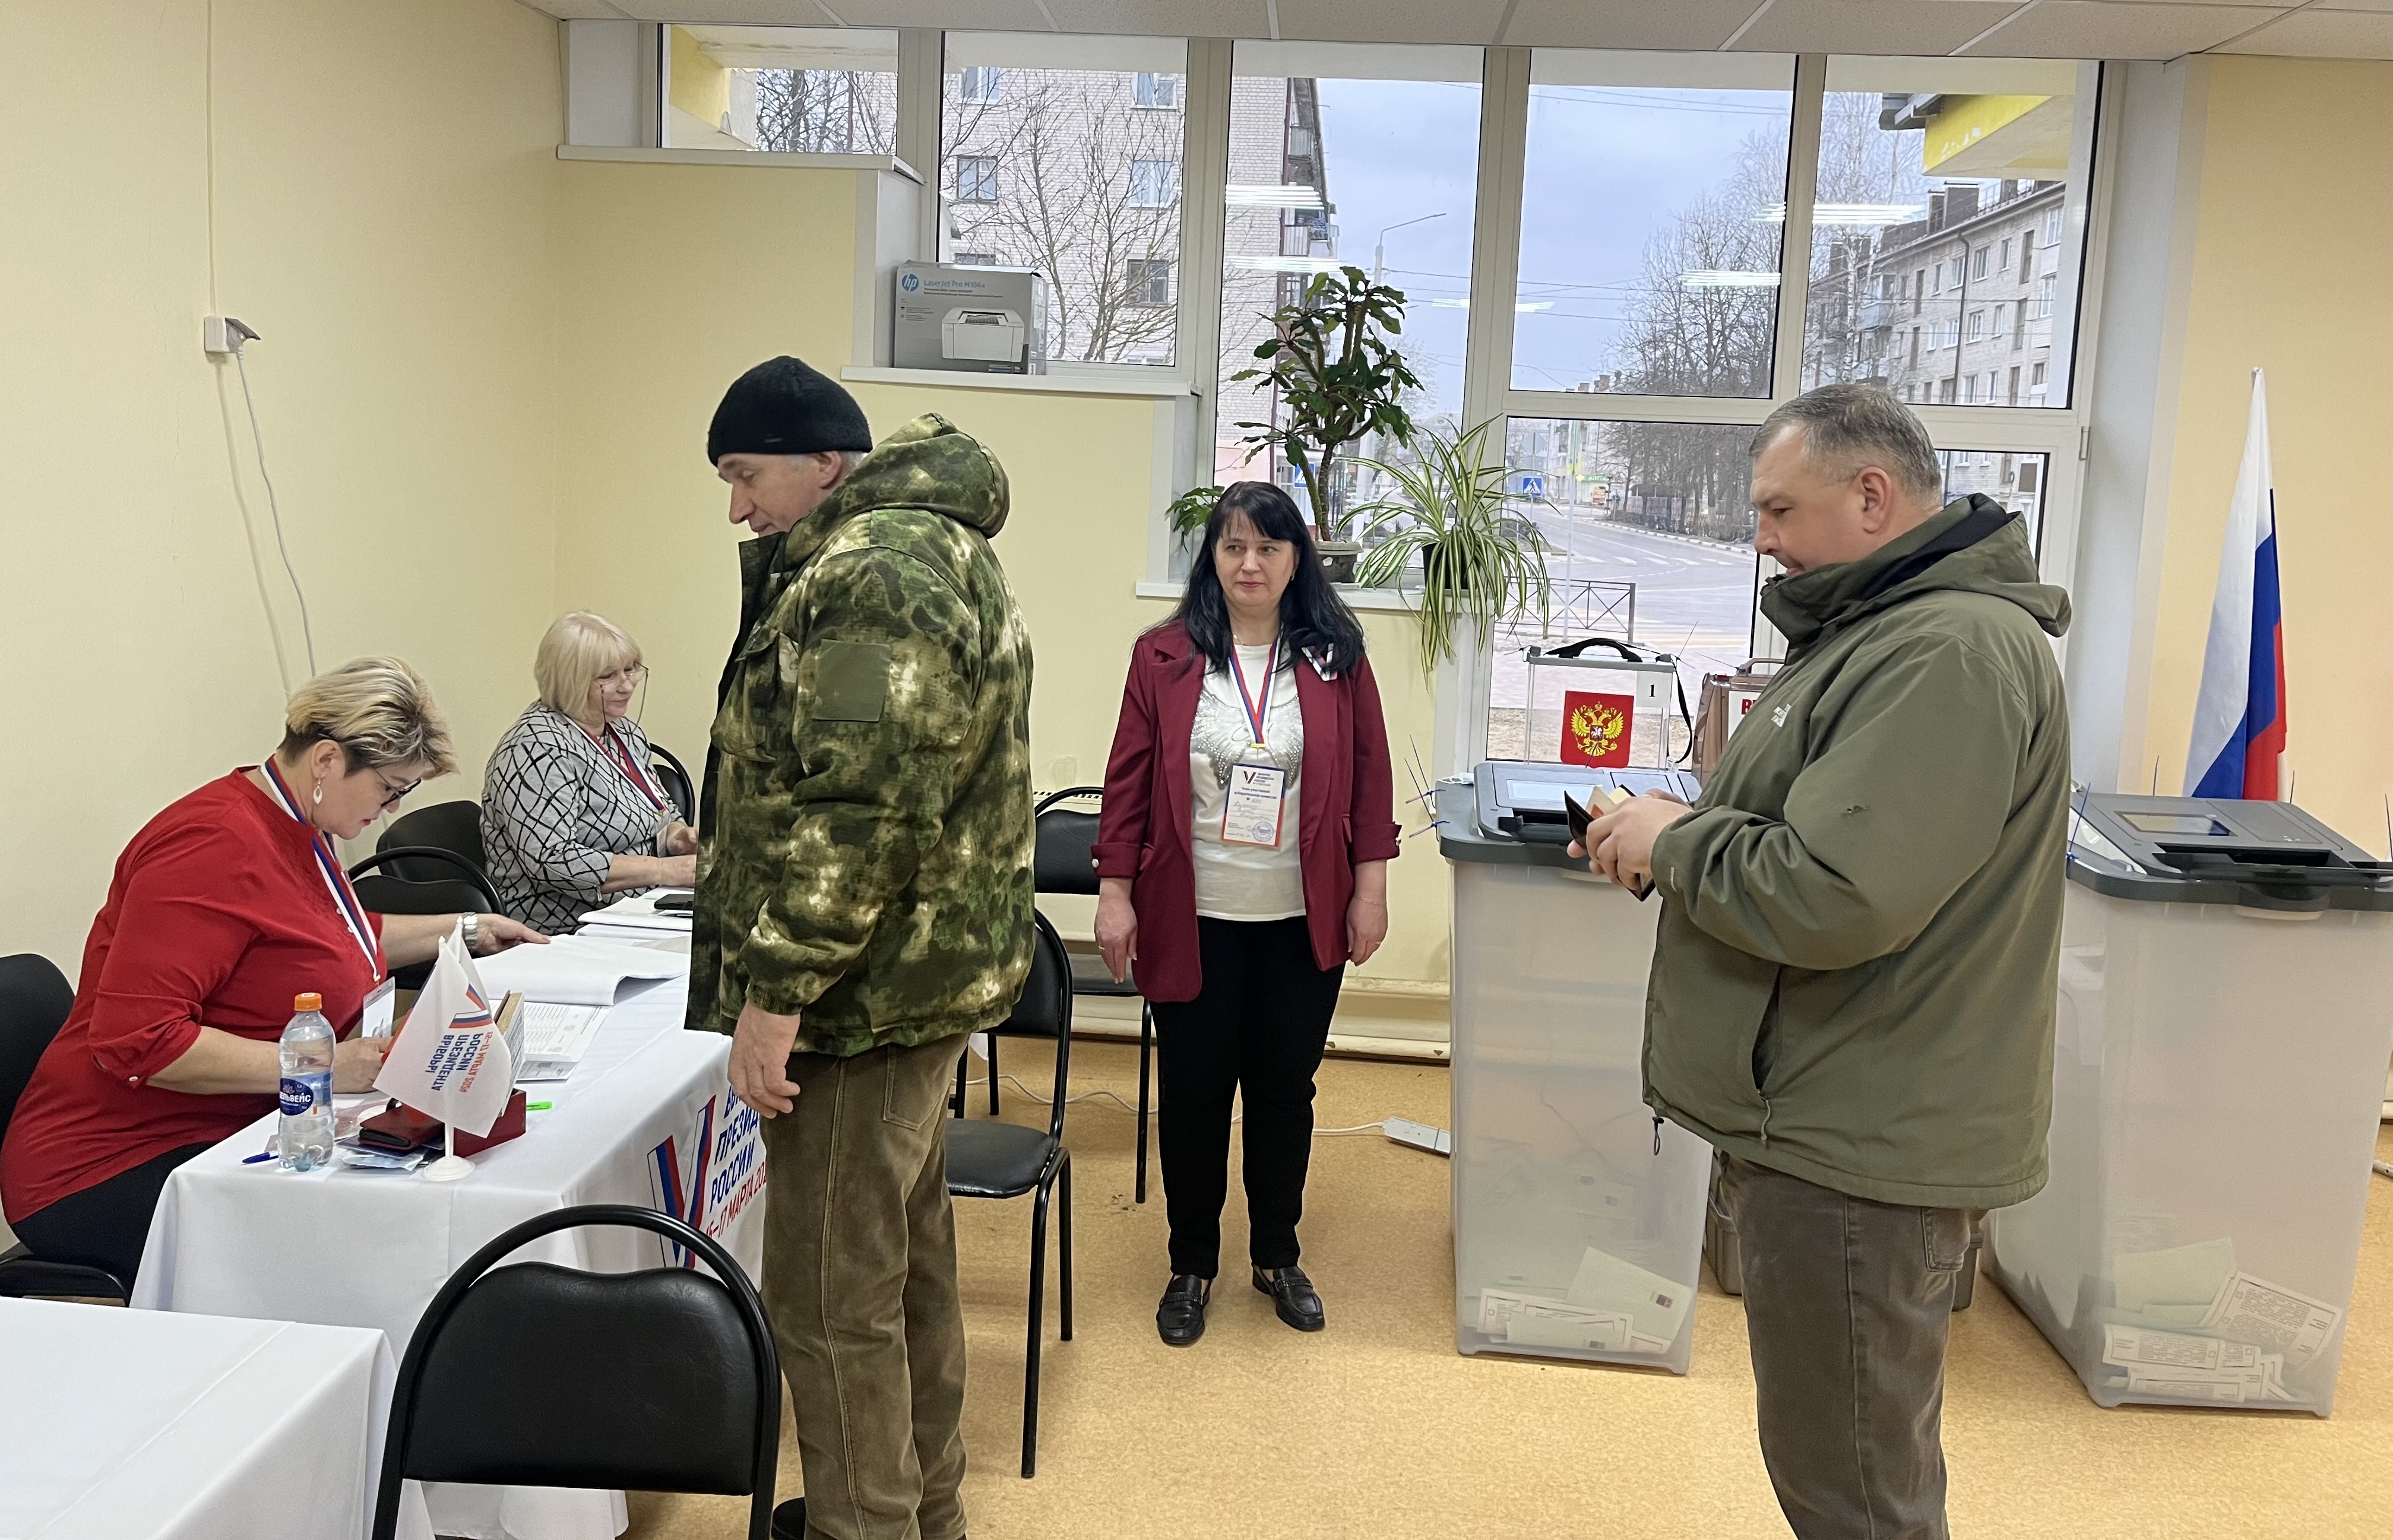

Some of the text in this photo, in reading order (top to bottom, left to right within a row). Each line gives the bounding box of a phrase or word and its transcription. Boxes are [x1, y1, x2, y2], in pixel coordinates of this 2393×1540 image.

[903, 274, 918, 291] hp
[924, 280, 951, 288] LaserJet
[1649, 684, 1656, 698] 1
[709, 1136, 755, 1214] РОССИИ
[727, 1174, 754, 1228] МАРТА
